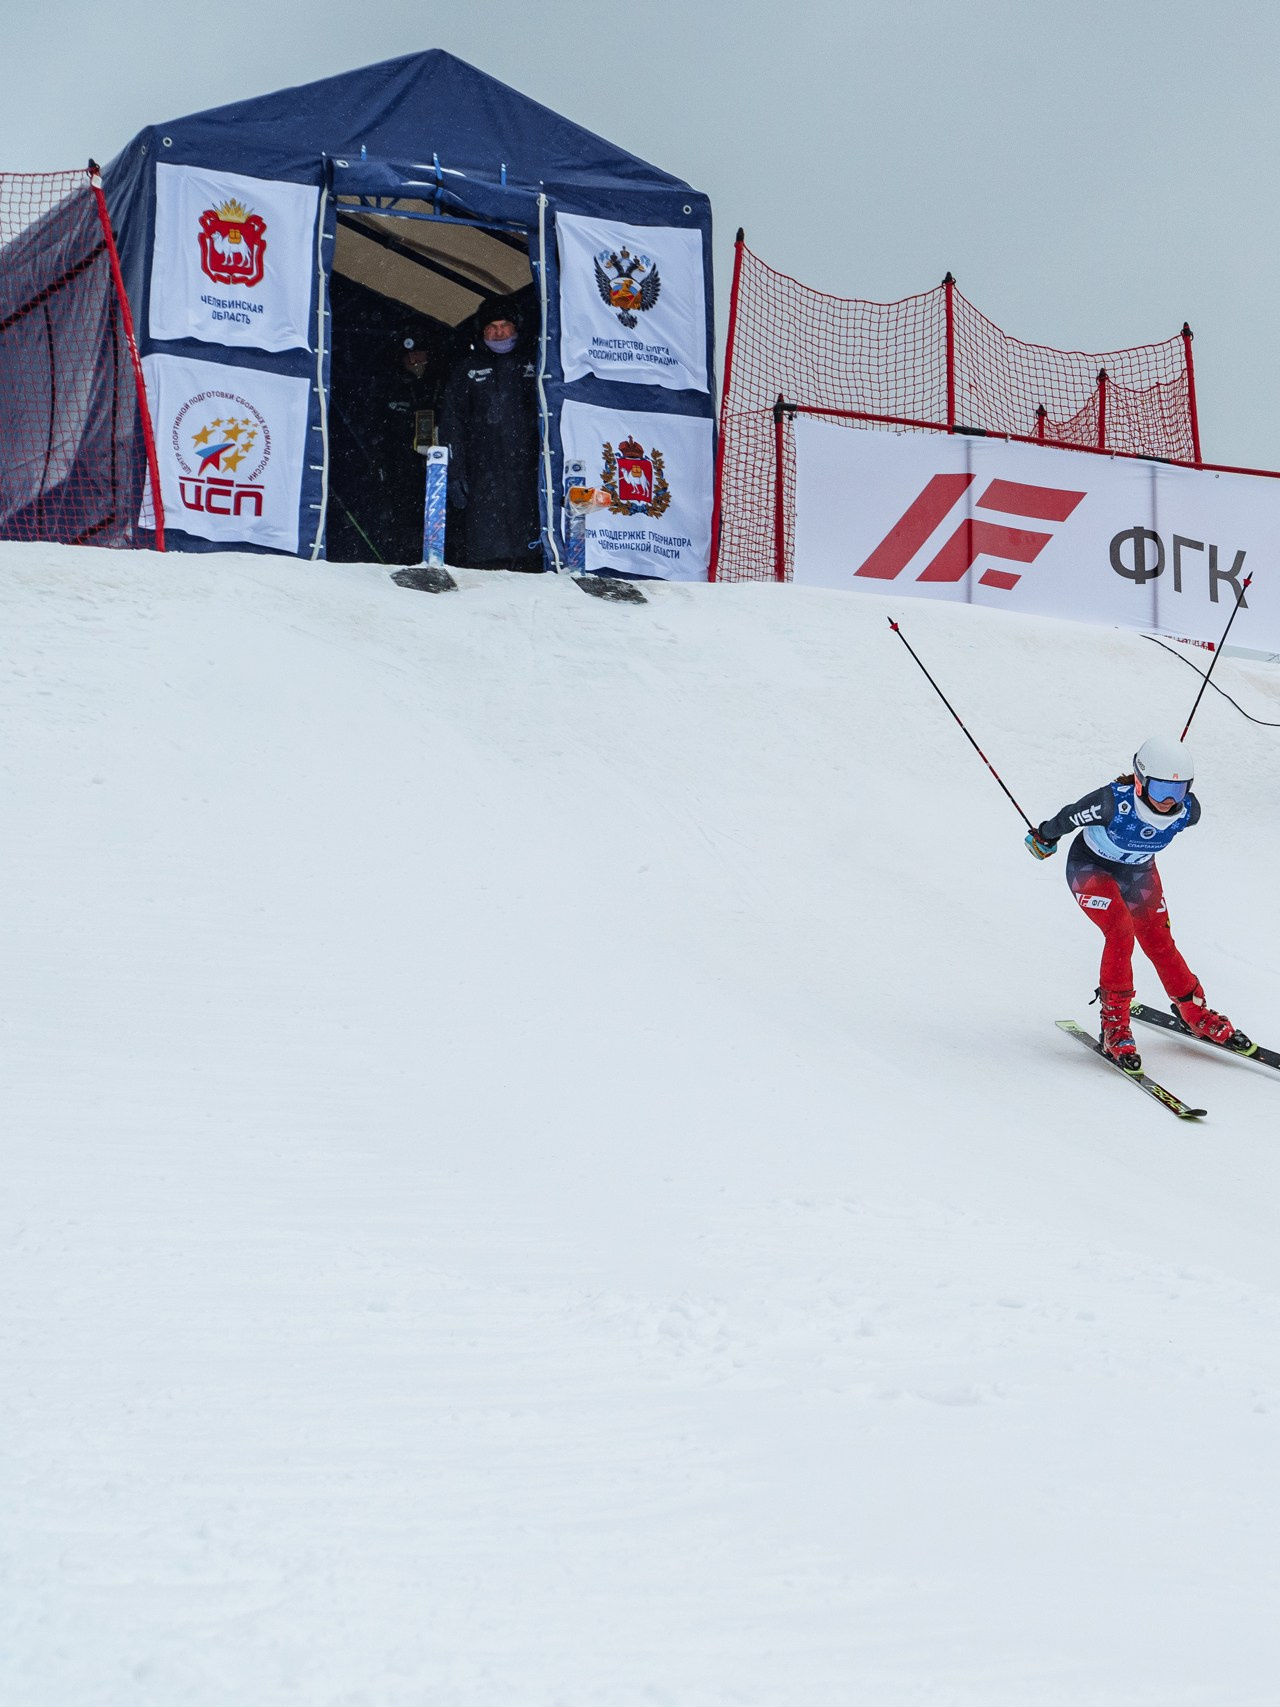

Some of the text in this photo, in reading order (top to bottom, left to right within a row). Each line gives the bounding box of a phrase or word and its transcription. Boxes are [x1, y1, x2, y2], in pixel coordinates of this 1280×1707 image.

[200, 295, 264, 314] ЧЕЛЯБИНСКАЯ
[212, 310, 251, 325] ОБЛАСТЬ
[588, 349, 634, 362] РОССИЙСКОЙ
[172, 390, 272, 482] ЦЕНТР СПОРТИВНОЙ ПОДГОТОВКИ СБОРНЫХ КОМАНД РОССИИ
[179, 482, 263, 517] ЦСП
[599, 529, 646, 541] ПОДДЕРЖКЕ
[649, 531, 692, 548] ГУБЕРНАТОРА
[598, 540, 680, 559] ЧЕЛЯБИНСКОЙ ОБЛАСТИ
[1109, 526, 1249, 609] ФГК
[1091, 899, 1109, 908] ФГК
